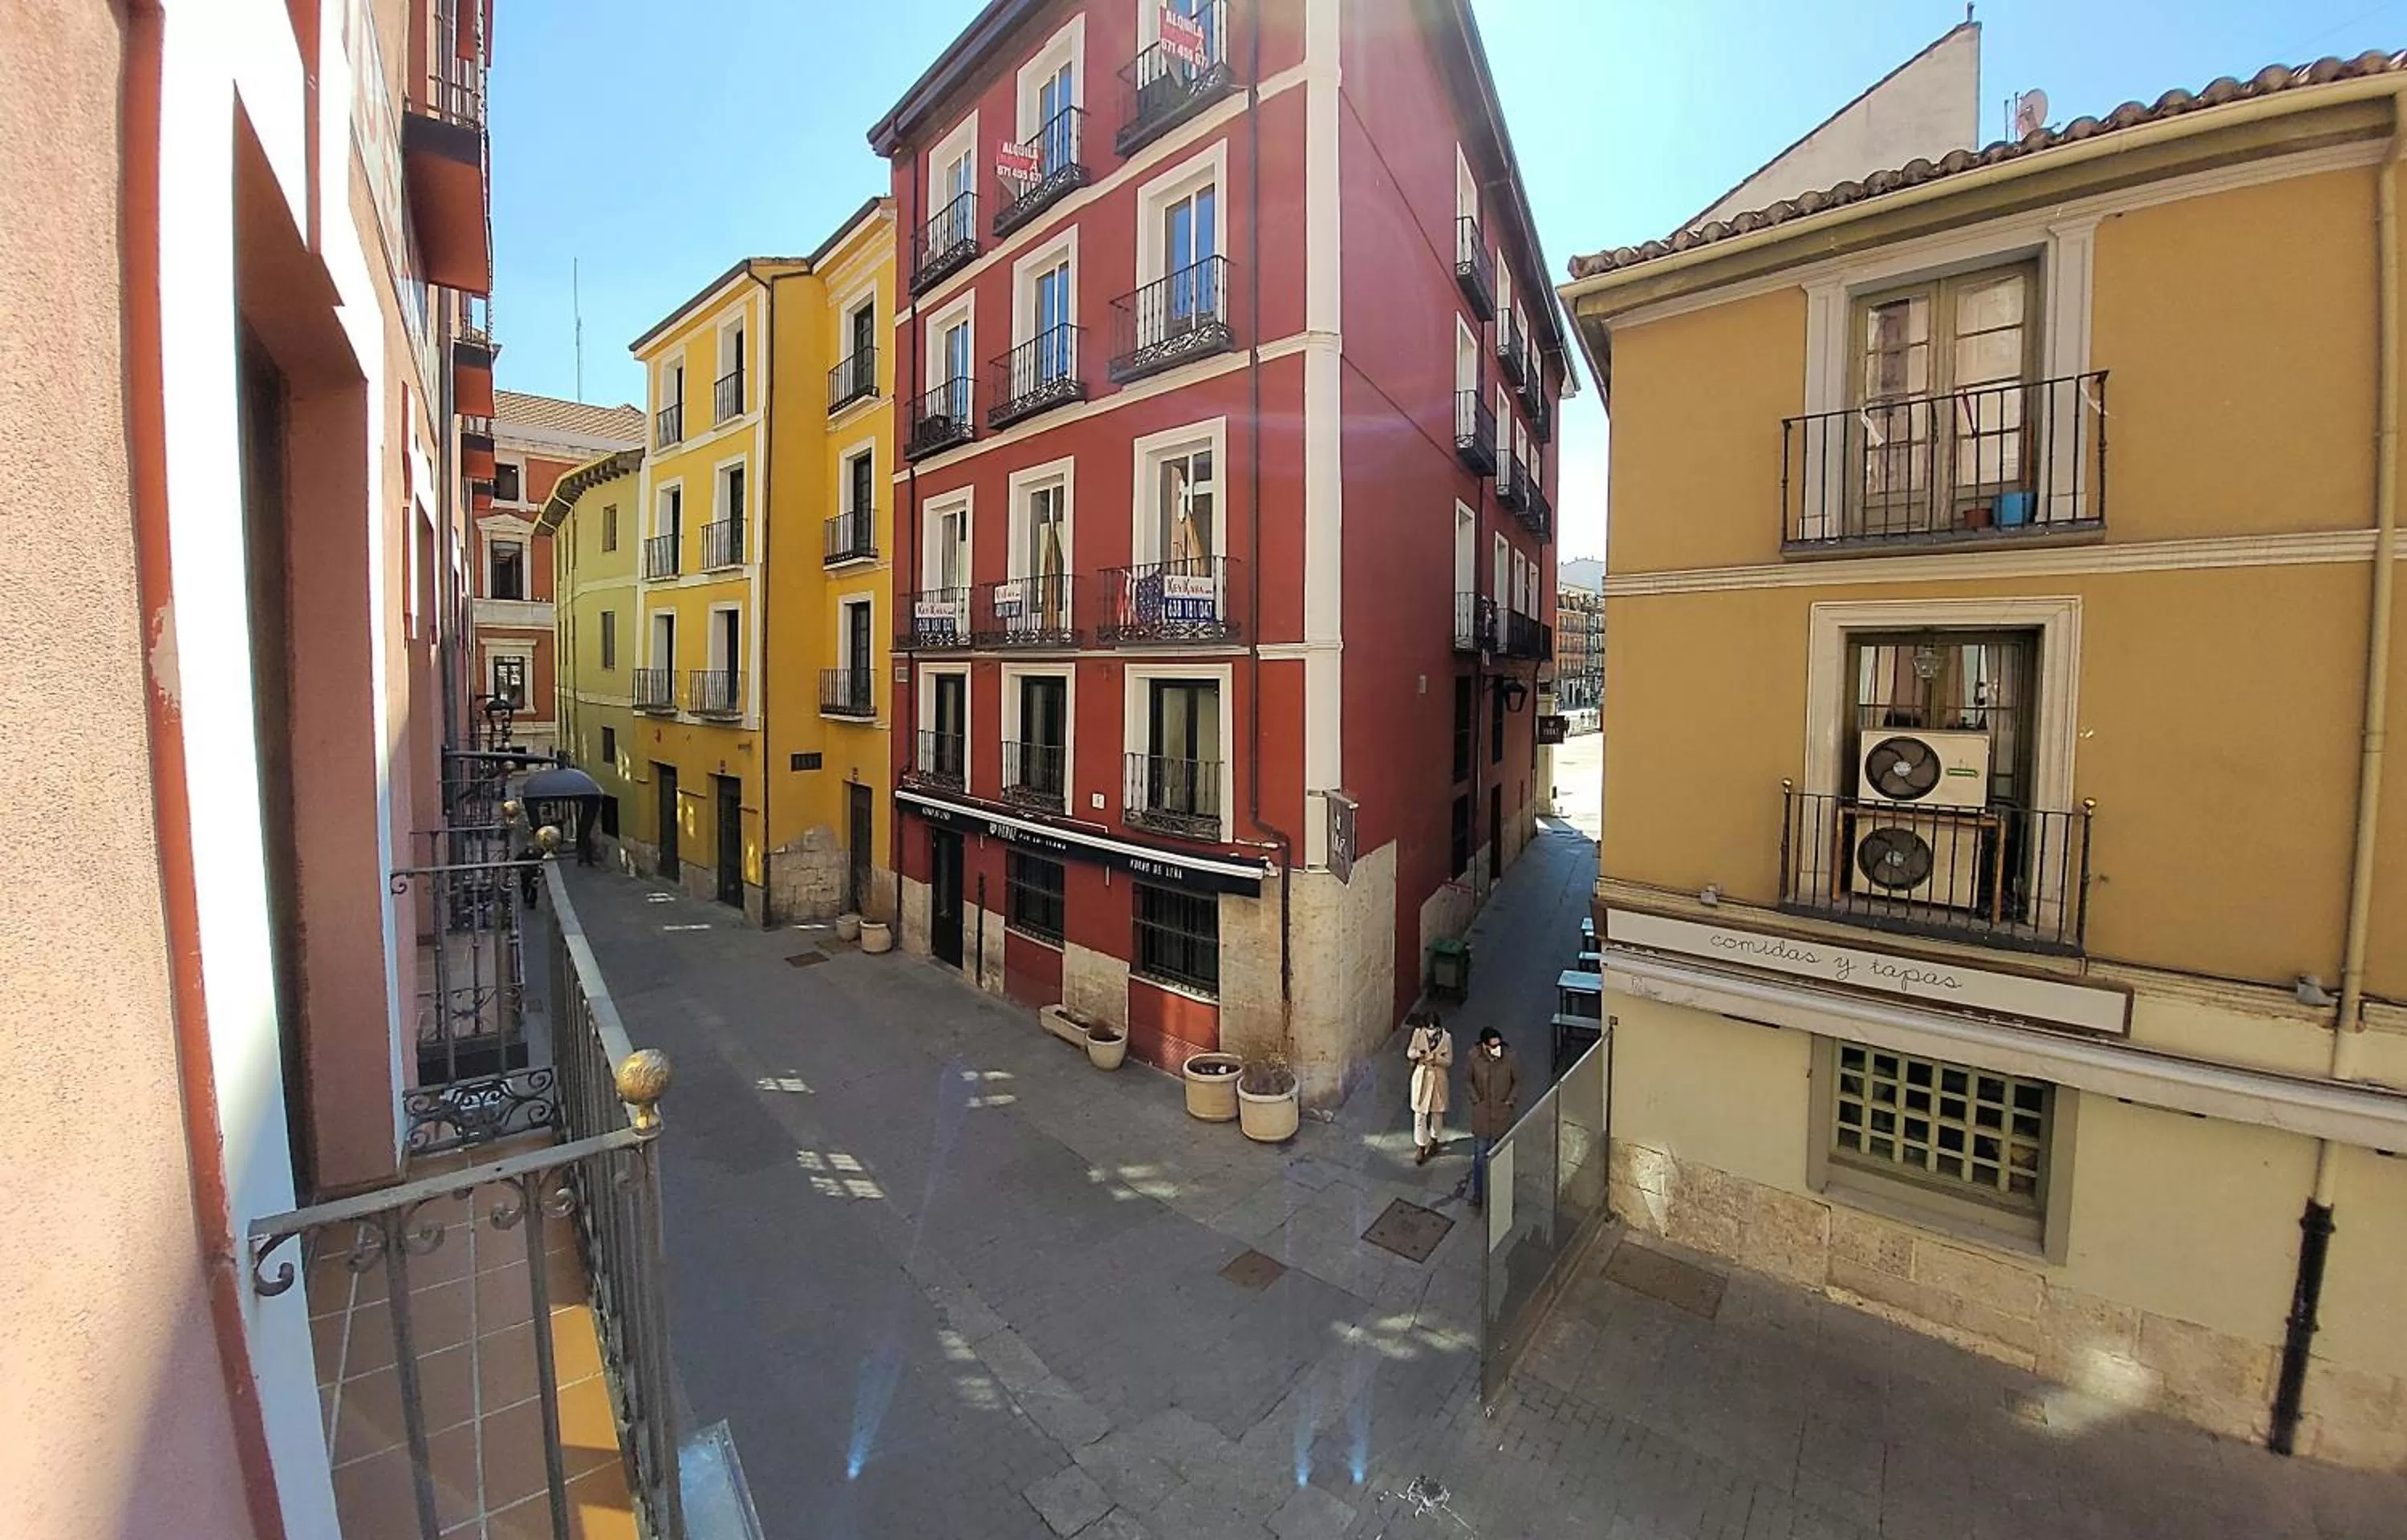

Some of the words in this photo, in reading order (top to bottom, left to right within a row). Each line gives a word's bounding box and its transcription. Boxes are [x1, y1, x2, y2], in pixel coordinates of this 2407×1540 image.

[1710, 934, 1821, 963] comidas
[1833, 957, 1857, 981] y
[1870, 958, 1963, 992] tapas
